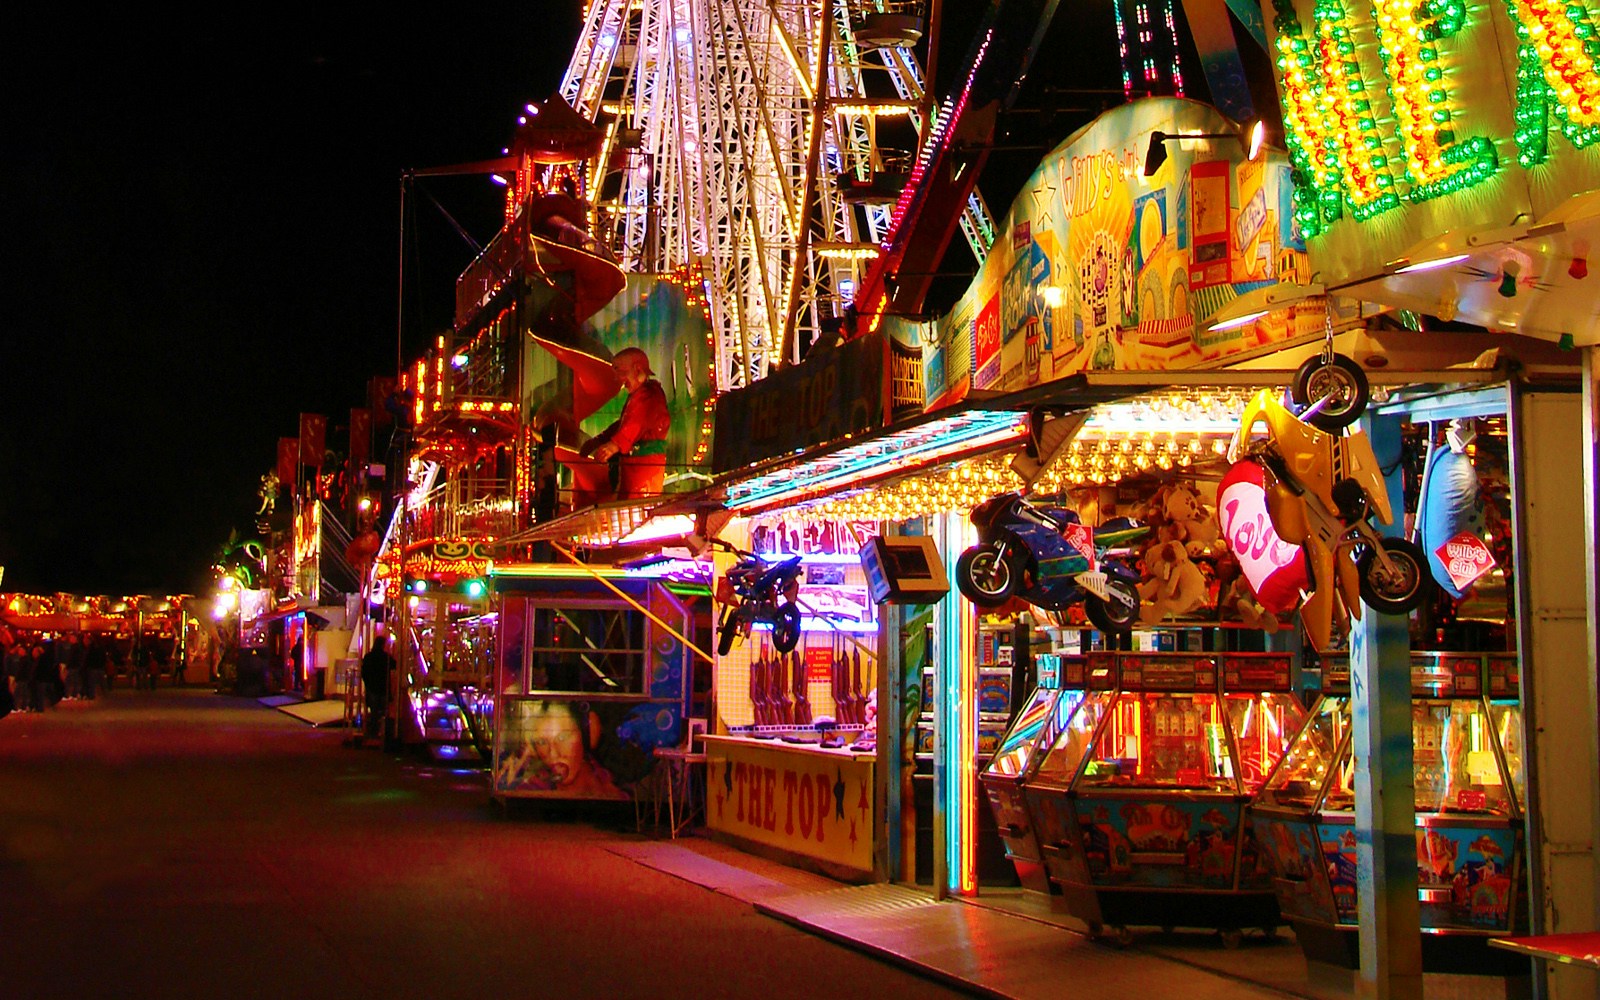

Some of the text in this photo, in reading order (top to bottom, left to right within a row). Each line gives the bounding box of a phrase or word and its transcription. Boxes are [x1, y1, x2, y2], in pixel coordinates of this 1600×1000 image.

[1058, 149, 1115, 221] Willy's
[734, 762, 832, 843] THE TOP
